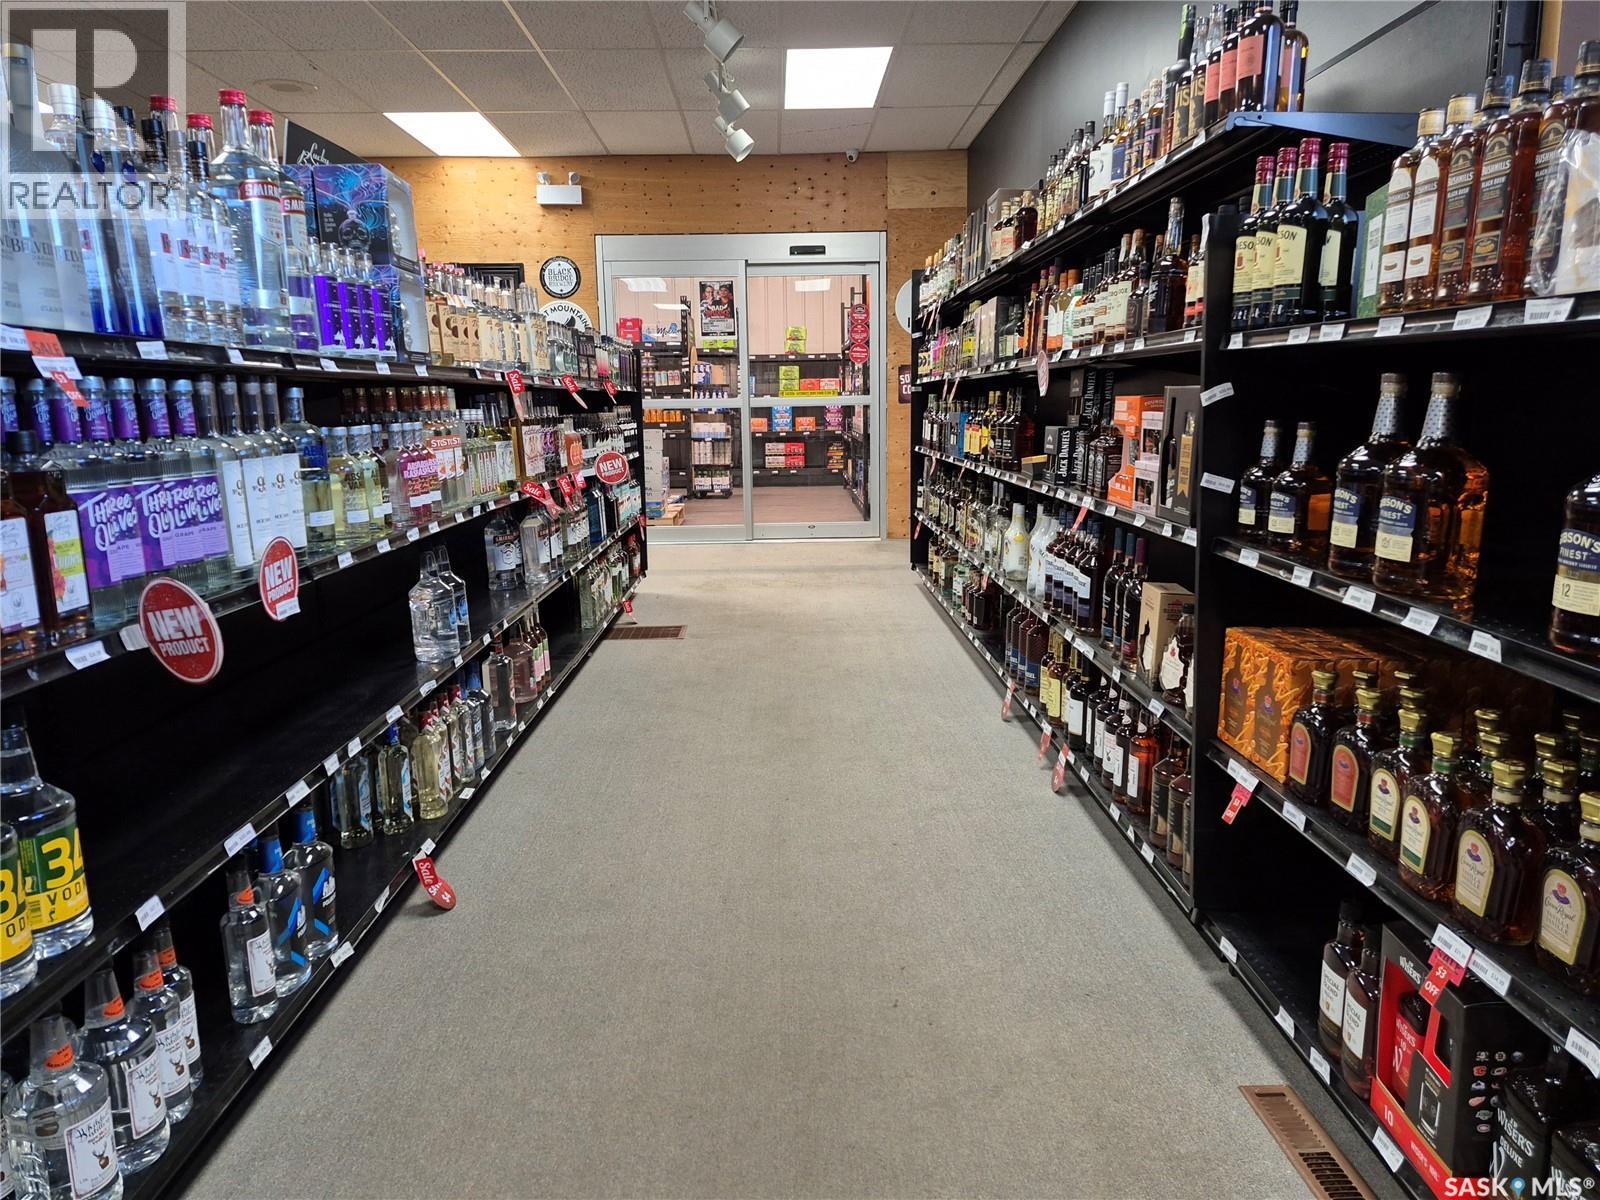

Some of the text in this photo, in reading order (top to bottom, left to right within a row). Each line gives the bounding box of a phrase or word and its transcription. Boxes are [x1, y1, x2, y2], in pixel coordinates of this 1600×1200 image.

[550, 304, 590, 328] MOUNTAIN
[507, 373, 522, 393] Sale
[599, 458, 623, 473] NEW
[1057, 459, 1069, 478] JACK
[524, 483, 542, 497] Sale
[264, 554, 293, 592] NEW
[1561, 583, 1571, 598] 12
[147, 604, 203, 642] NEW
[157, 636, 211, 658] PRODUCT
[418, 862, 435, 886] Sale
[1435, 966, 1448, 980] $3
[1424, 981, 1441, 997] OFF
[1384, 1104, 1394, 1127] 10
[1497, 1107, 1535, 1157] WISER'S
[1500, 1135, 1523, 1168] DELUXE
